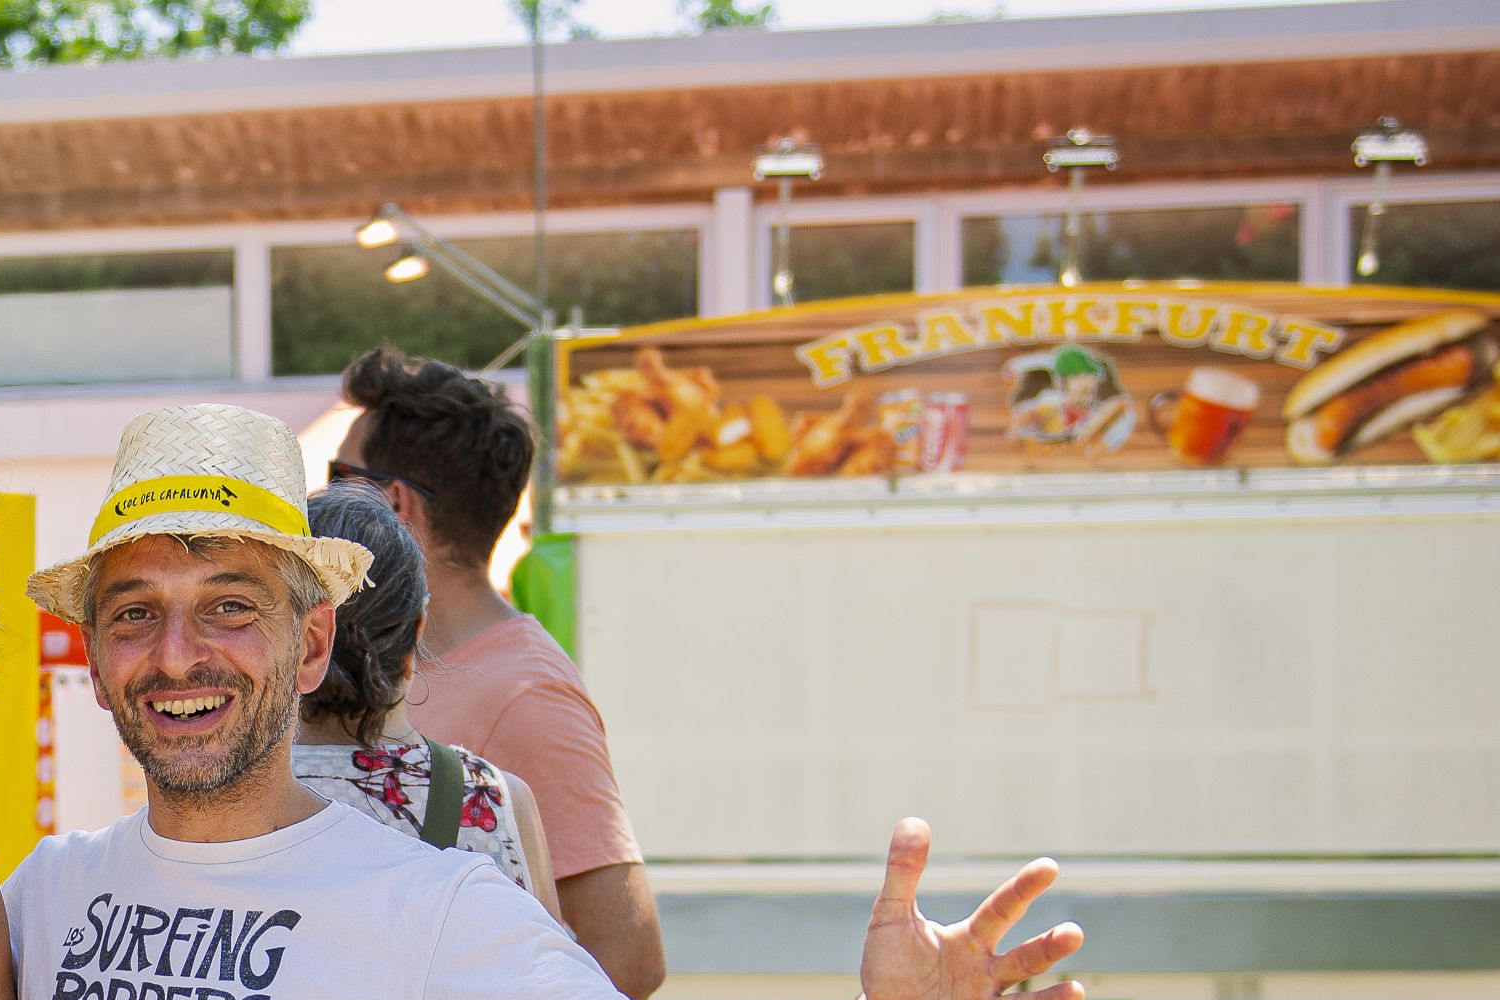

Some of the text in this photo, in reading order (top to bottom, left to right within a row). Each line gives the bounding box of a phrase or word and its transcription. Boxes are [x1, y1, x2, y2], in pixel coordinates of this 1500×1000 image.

[798, 300, 1344, 386] FRANKFURT
[140, 491, 156, 506] DEL
[62, 925, 85, 948] LOS
